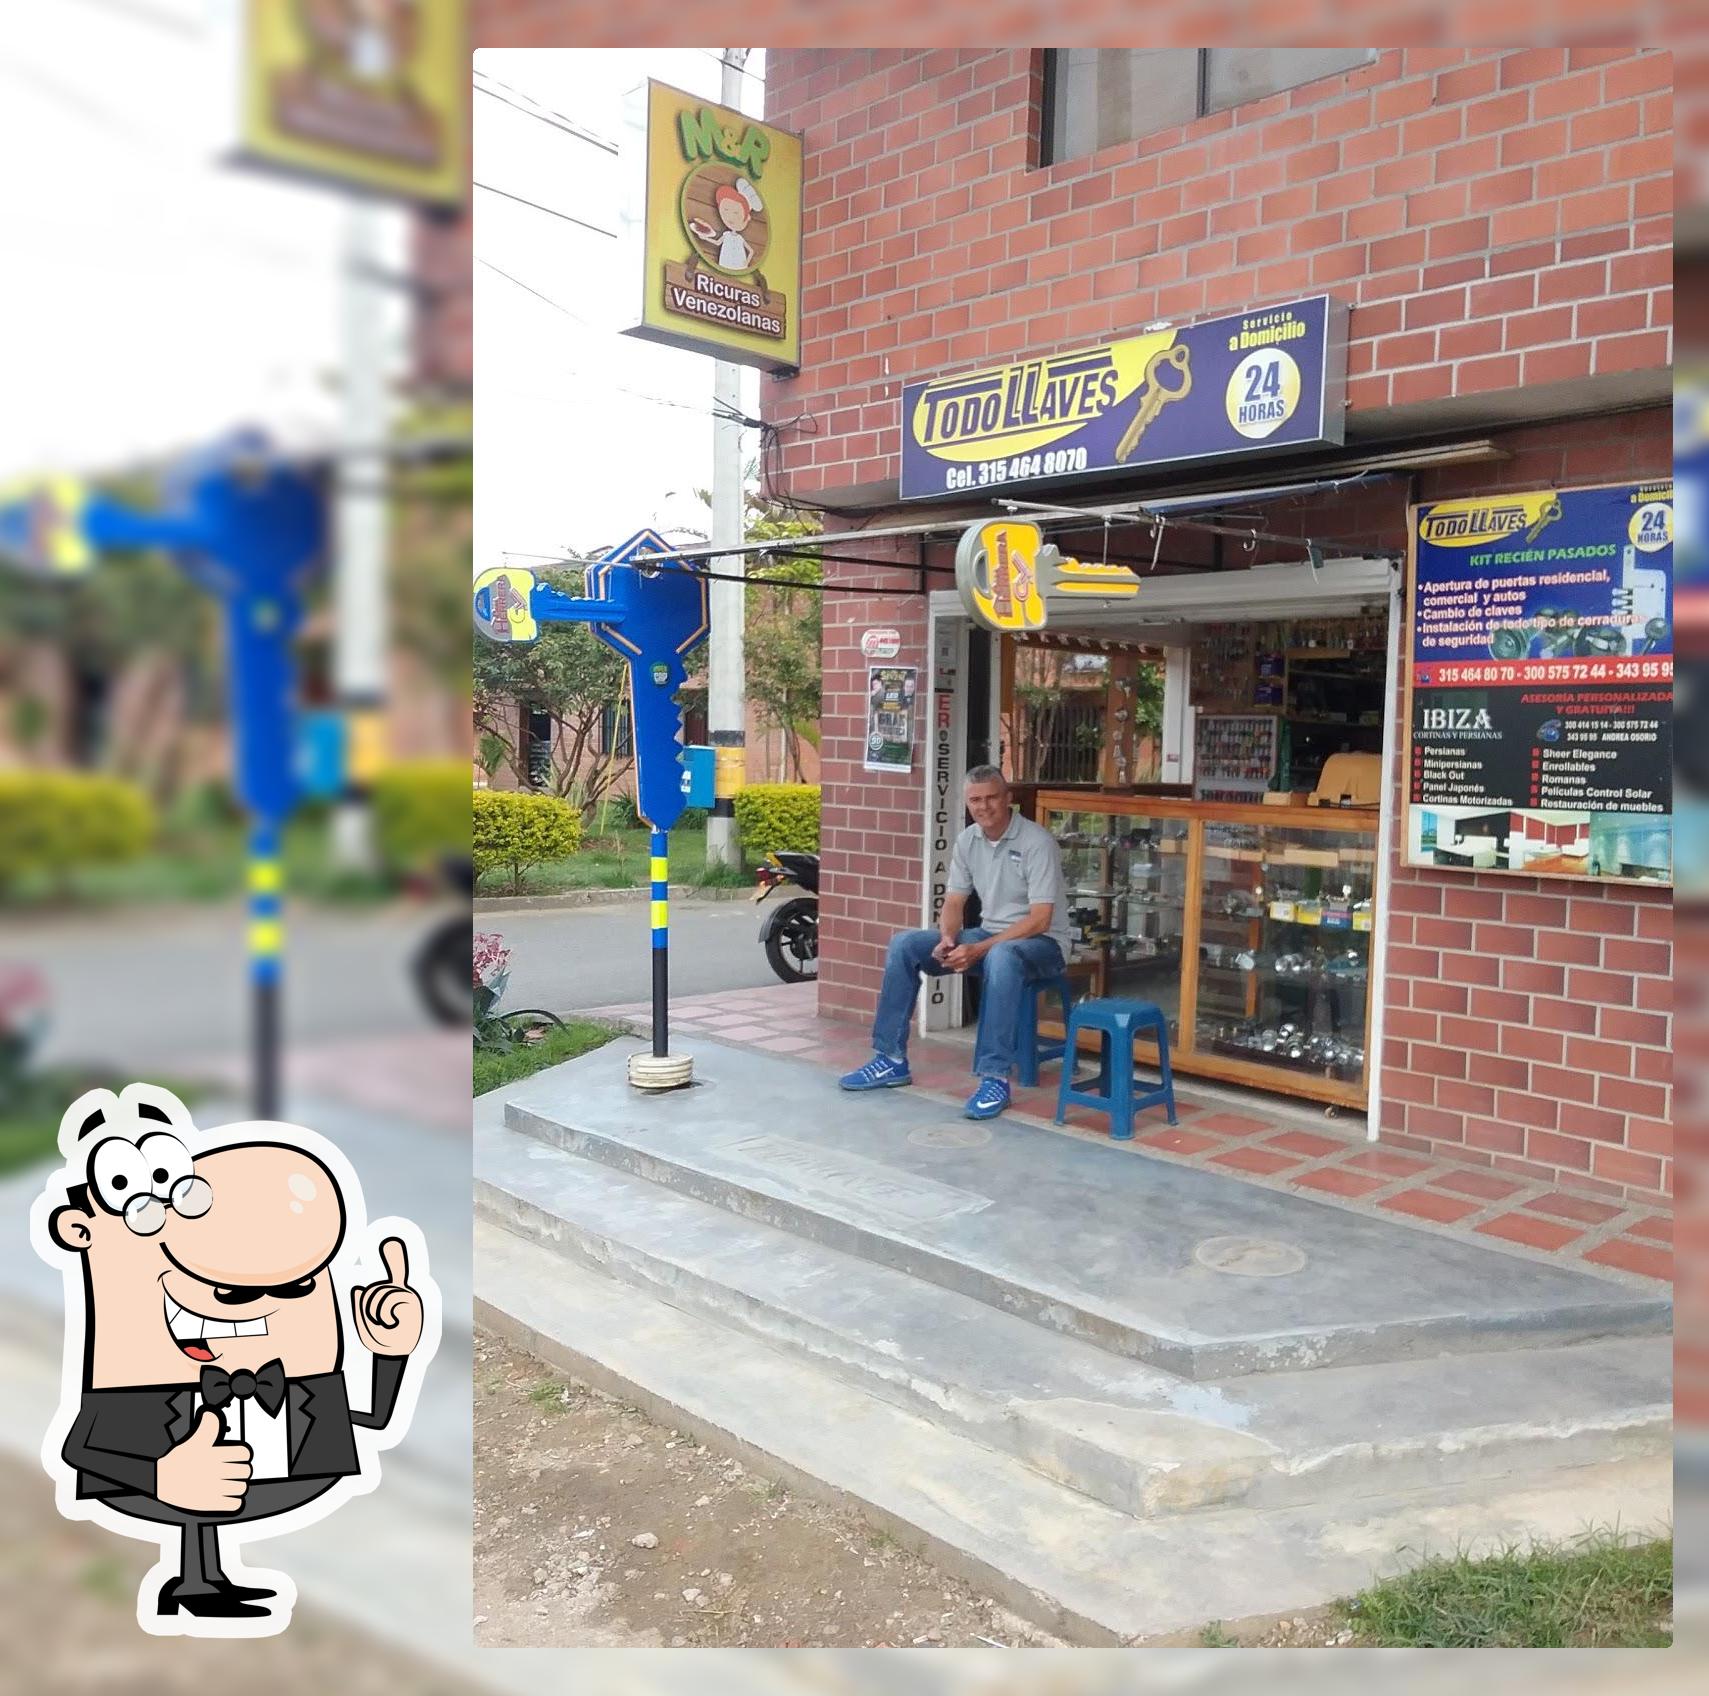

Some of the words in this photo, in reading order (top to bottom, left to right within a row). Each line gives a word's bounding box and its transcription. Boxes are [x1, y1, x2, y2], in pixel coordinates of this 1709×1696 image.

[697, 274, 760, 307] Ricuras
[674, 287, 781, 334] Venezolanas
[1242, 311, 1293, 330] Servicio
[1228, 336, 1239, 351] a
[1240, 320, 1306, 349] Domicilio
[1244, 361, 1281, 402] 24
[1238, 399, 1285, 423] HORAS
[946, 465, 976, 489] Cel.
[978, 460, 1007, 485] 315
[1009, 455, 1041, 479] 464
[1043, 447, 1088, 474] 8070
[1642, 510, 1665, 532] 24
[1637, 531, 1668, 544] HORAS
[1469, 554, 1492, 567] KIT
[1547, 543, 1616, 561] PASADOS
[1423, 581, 1472, 594] Apertura
[1474, 577, 1489, 589] de
[1491, 574, 1537, 591] puertas
[1539, 569, 1610, 584] residencial,
[1423, 592, 1478, 606] comercial
[1483, 593, 1490, 605] y
[1493, 590, 1526, 602] autos
[1422, 606, 1465, 620] Cambio
[1467, 606, 1482, 617] de
[1484, 605, 1522, 616] claves
[1422, 620, 1483, 634] Instalación
[1485, 619, 1499, 631] de
[1502, 618, 1530, 630] todo
[1533, 616, 1556, 630] tipo
[1559, 615, 1575, 627] de
[1422, 636, 1436, 647] de
[1438, 633, 1494, 648] seguridad
[1438, 668, 1459, 682] 315
[1461, 666, 1481, 681] 464
[1483, 666, 1497, 680] 80
[1500, 665, 1514, 679] 70
[1523, 664, 1545, 679] 300
[1547, 662, 1569, 678] 575
[1572, 662, 1588, 677] 72
[1590, 661, 1607, 676] 44
[1616, 662, 1639, 678] 343
[1642, 662, 1659, 677] 95
[1422, 708, 1493, 730] IBIZA
[1413, 731, 1451, 739] CORTINAS
[1460, 731, 1503, 740] PERSIANAS
[1424, 746, 1466, 756] Persianas
[1573, 749, 1617, 761] Elegance
[1424, 760, 1483, 770] Minipersianas
[1542, 762, 1596, 772] Enrollables
[1423, 770, 1447, 780] Black
[1449, 770, 1465, 780] Out
[1542, 774, 1586, 785] Romanas
[1448, 783, 1485, 793] Japonés
[1586, 787, 1622, 798] Control
[1625, 788, 1653, 799] Solar
[1422, 794, 1458, 804] Cortinas
[1460, 795, 1513, 807] Motorizadas
[1540, 798, 1603, 811] Restauración
[1605, 800, 1619, 811] de
[1621, 801, 1664, 813] muebles
[934, 862, 946, 874] A
